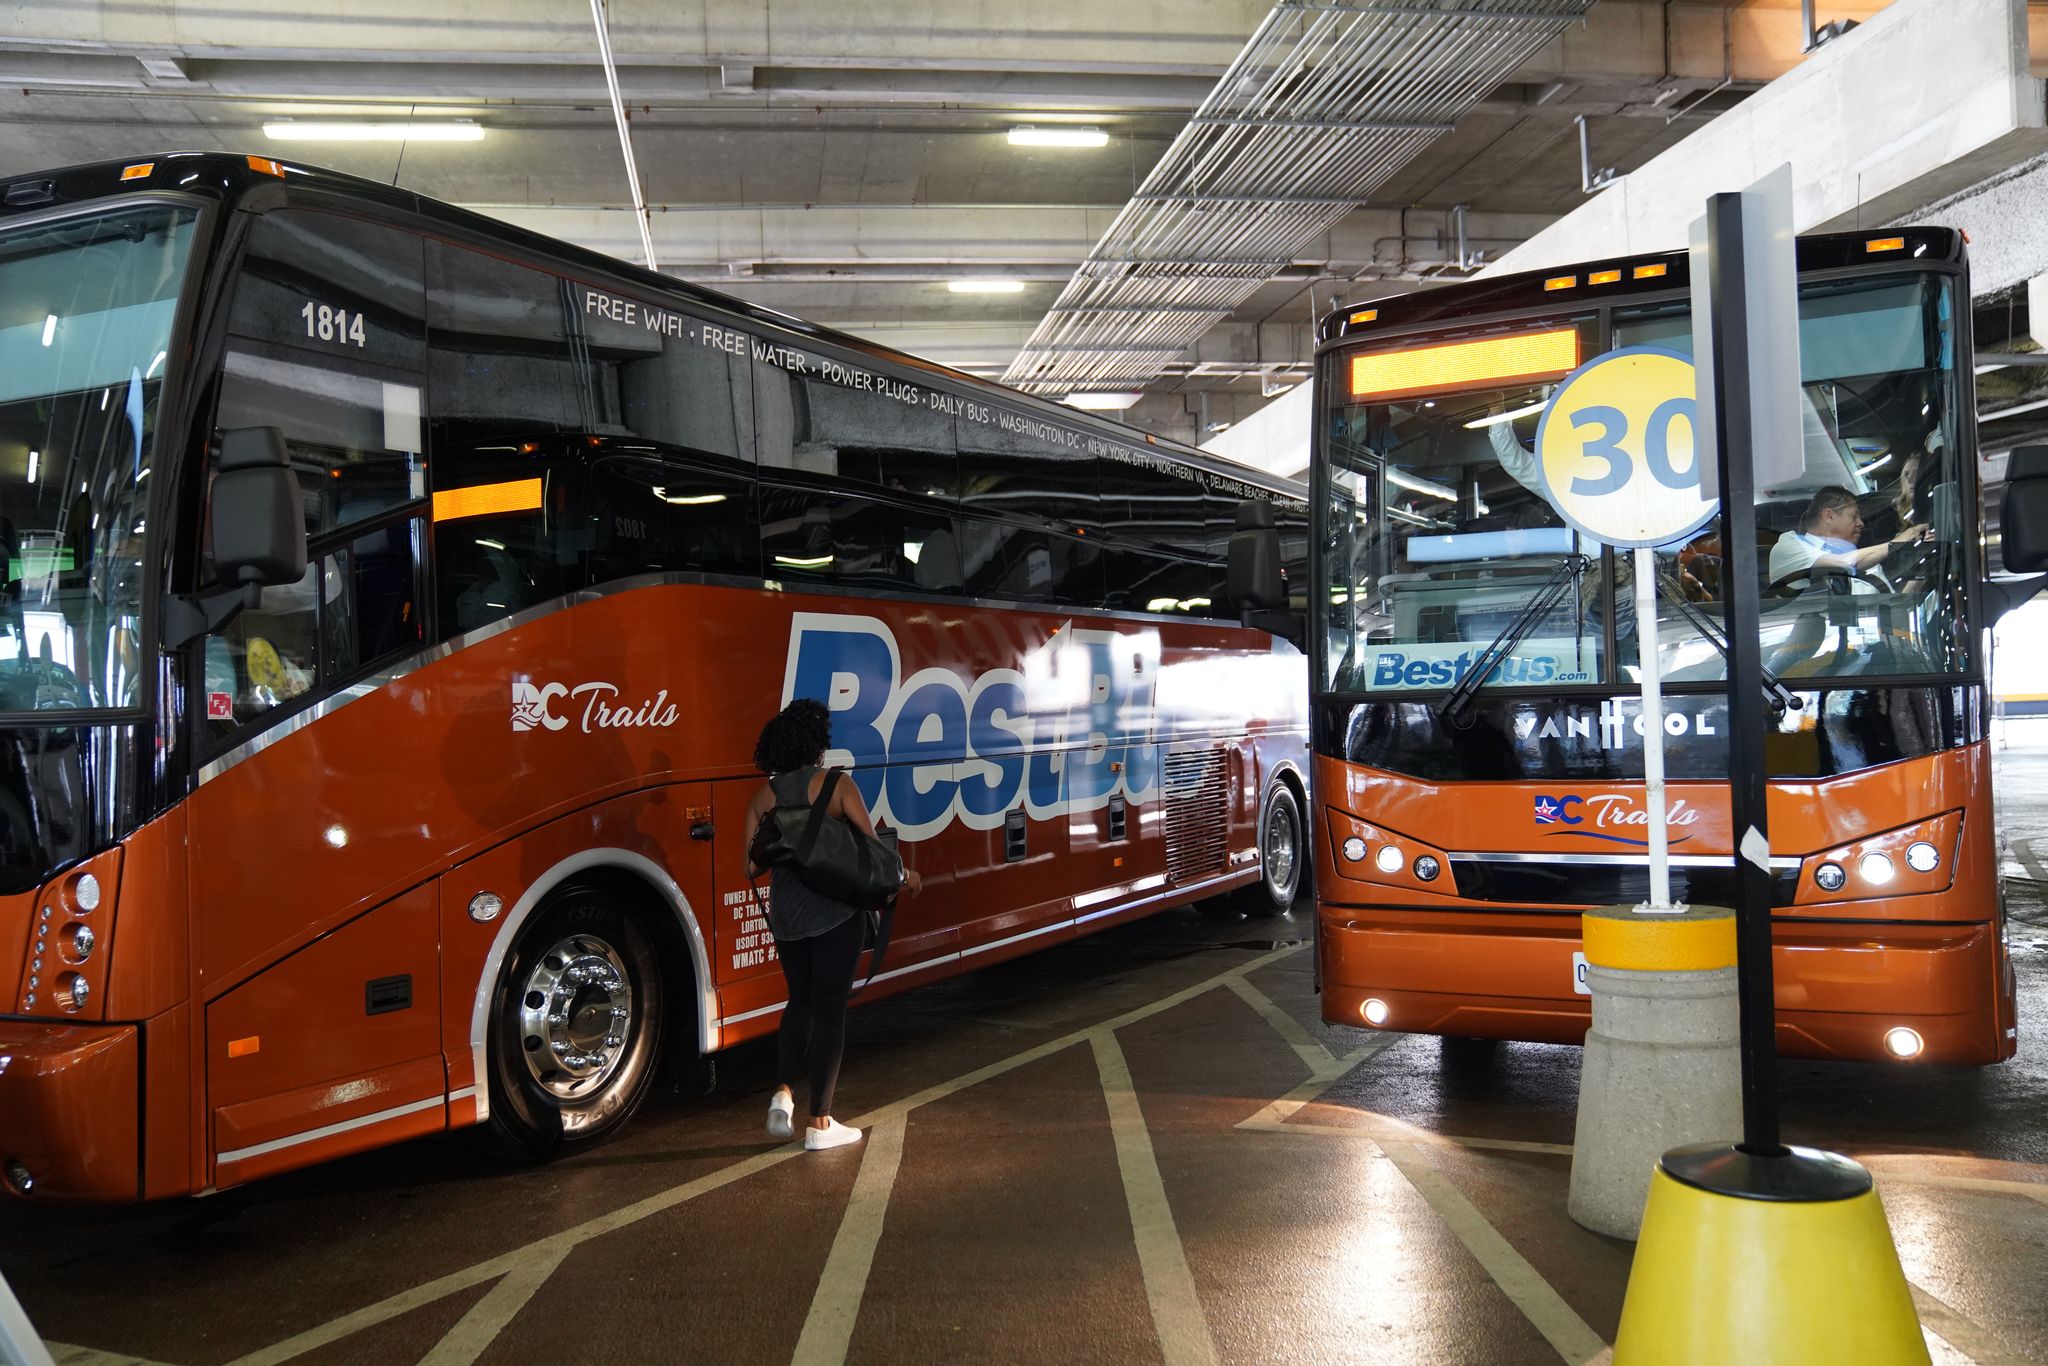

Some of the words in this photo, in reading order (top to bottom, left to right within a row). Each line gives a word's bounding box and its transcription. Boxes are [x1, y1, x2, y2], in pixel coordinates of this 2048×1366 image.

[302, 301, 366, 348] 1814
[586, 291, 636, 325] FREE
[643, 308, 683, 338] WIFI
[702, 326, 745, 356] FREE
[750, 339, 807, 373] WATER
[822, 361, 873, 392] POWER
[876, 377, 918, 404] PLUGS
[930, 393, 964, 416] DAILY
[967, 403, 989, 424] BUS
[999, 413, 1064, 445] WASHINGTON
[1067, 432, 1080, 449] DC
[1087, 439, 1107, 456] NEW
[1108, 443, 1131, 464] YORK
[1132, 452, 1151, 470] CITY
[1156, 460, 1194, 481] NORTHERN
[1194, 471, 1205, 485] VA
[1209, 474, 1244, 496] DELAWARE
[1243, 485, 1270, 501] BEACHES
[1569, 397, 1701, 497] 30
[510, 681, 569, 732] DC
[570, 681, 680, 734] Trails
[1535, 794, 1584, 825] DC
[1586, 794, 1699, 828] Trals
[724, 890, 746, 906] OWNED
[749, 889, 754, 901] &
[733, 906, 743, 920] DC
[745, 901, 770, 917] TRAS
[732, 948, 764, 969] WMATC
[735, 934, 759, 950] USDOT
